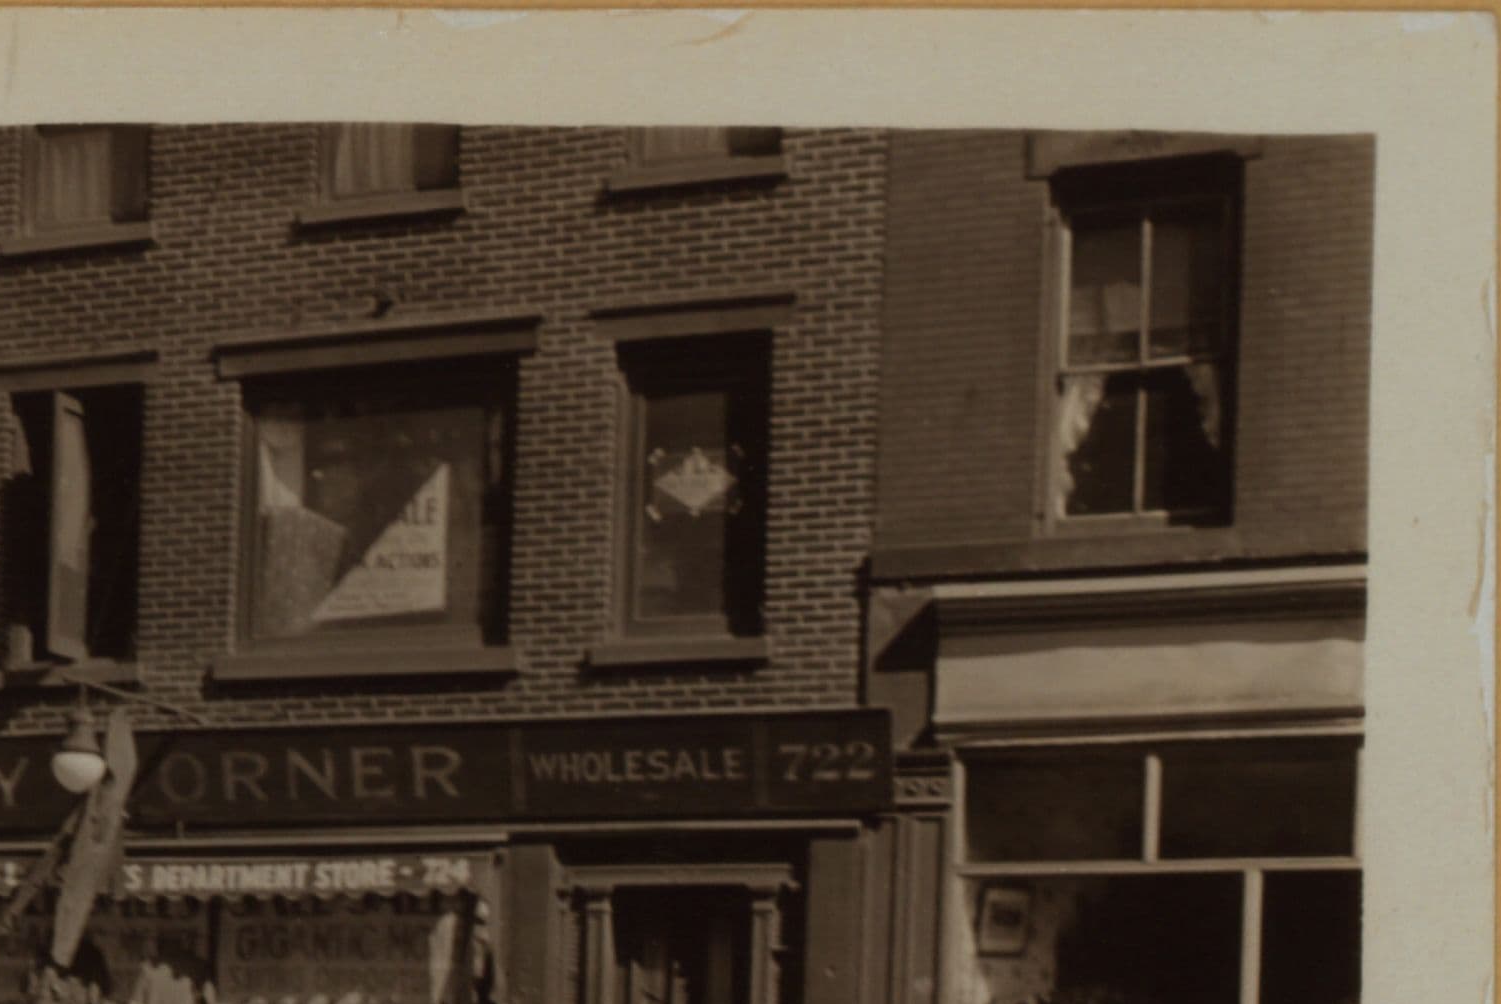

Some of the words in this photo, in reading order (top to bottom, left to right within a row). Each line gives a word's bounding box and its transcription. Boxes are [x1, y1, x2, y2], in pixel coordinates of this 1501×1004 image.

[156, 745, 464, 802] ORNER
[528, 749, 747, 783] WHOLESALE
[778, 742, 876, 781] 722
[152, 861, 308, 891] DEPARTMENT
[314, 858, 396, 890] STORE
